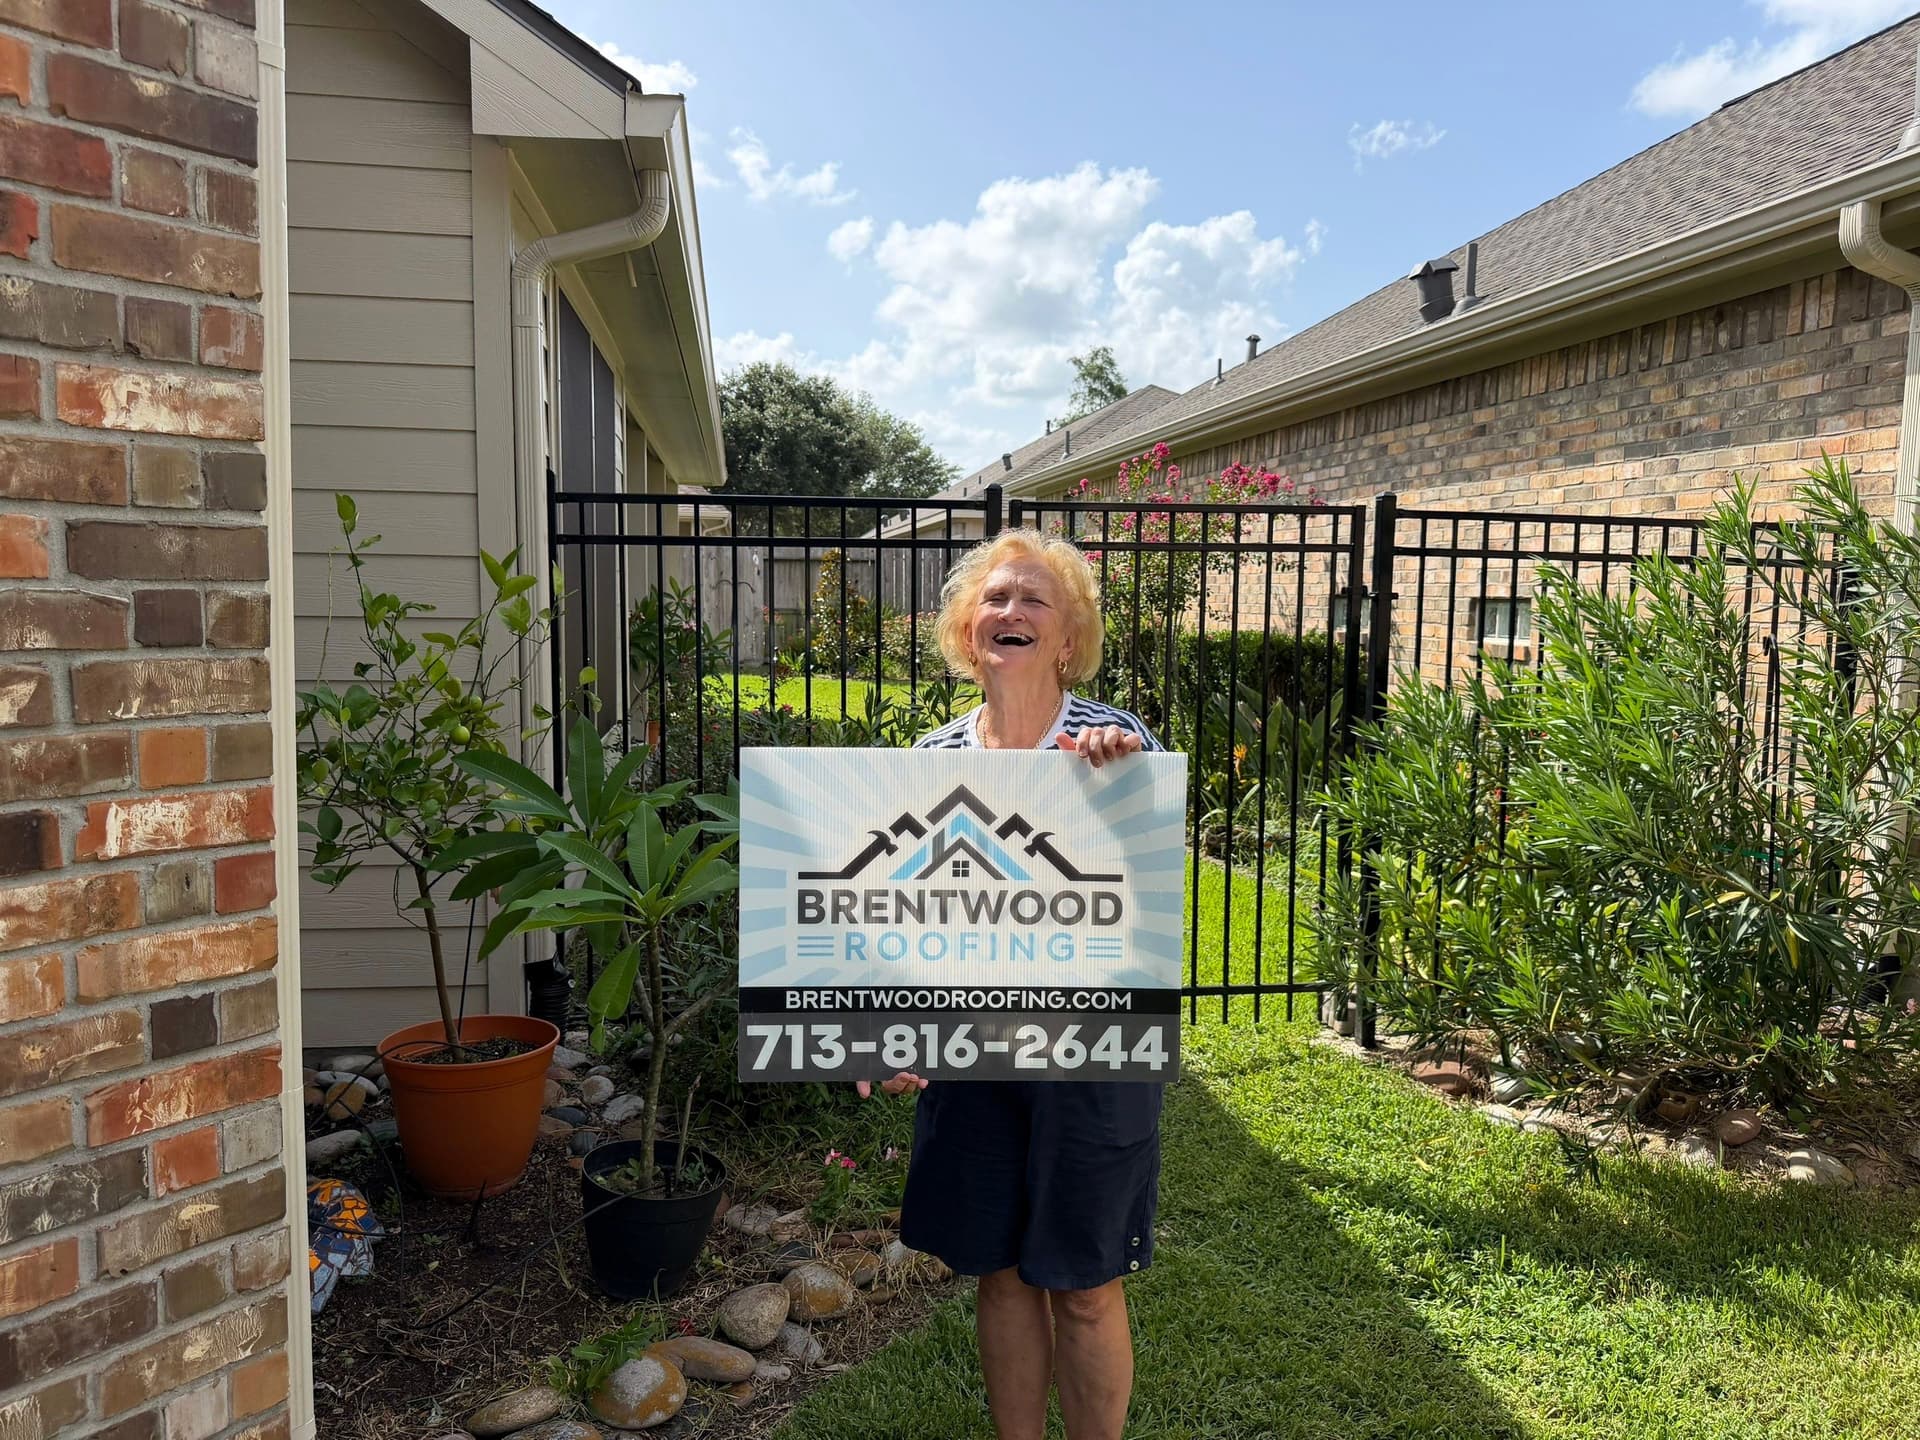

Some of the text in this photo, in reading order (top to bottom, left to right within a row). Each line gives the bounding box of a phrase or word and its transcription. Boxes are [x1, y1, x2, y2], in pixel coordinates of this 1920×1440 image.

[797, 889, 1124, 926] BRENTWOOD
[845, 931, 1075, 962] ROOFING
[785, 990, 1132, 1010] BRENTWOODROOFING.COM
[746, 1023, 1169, 1071] 713-816-2644
